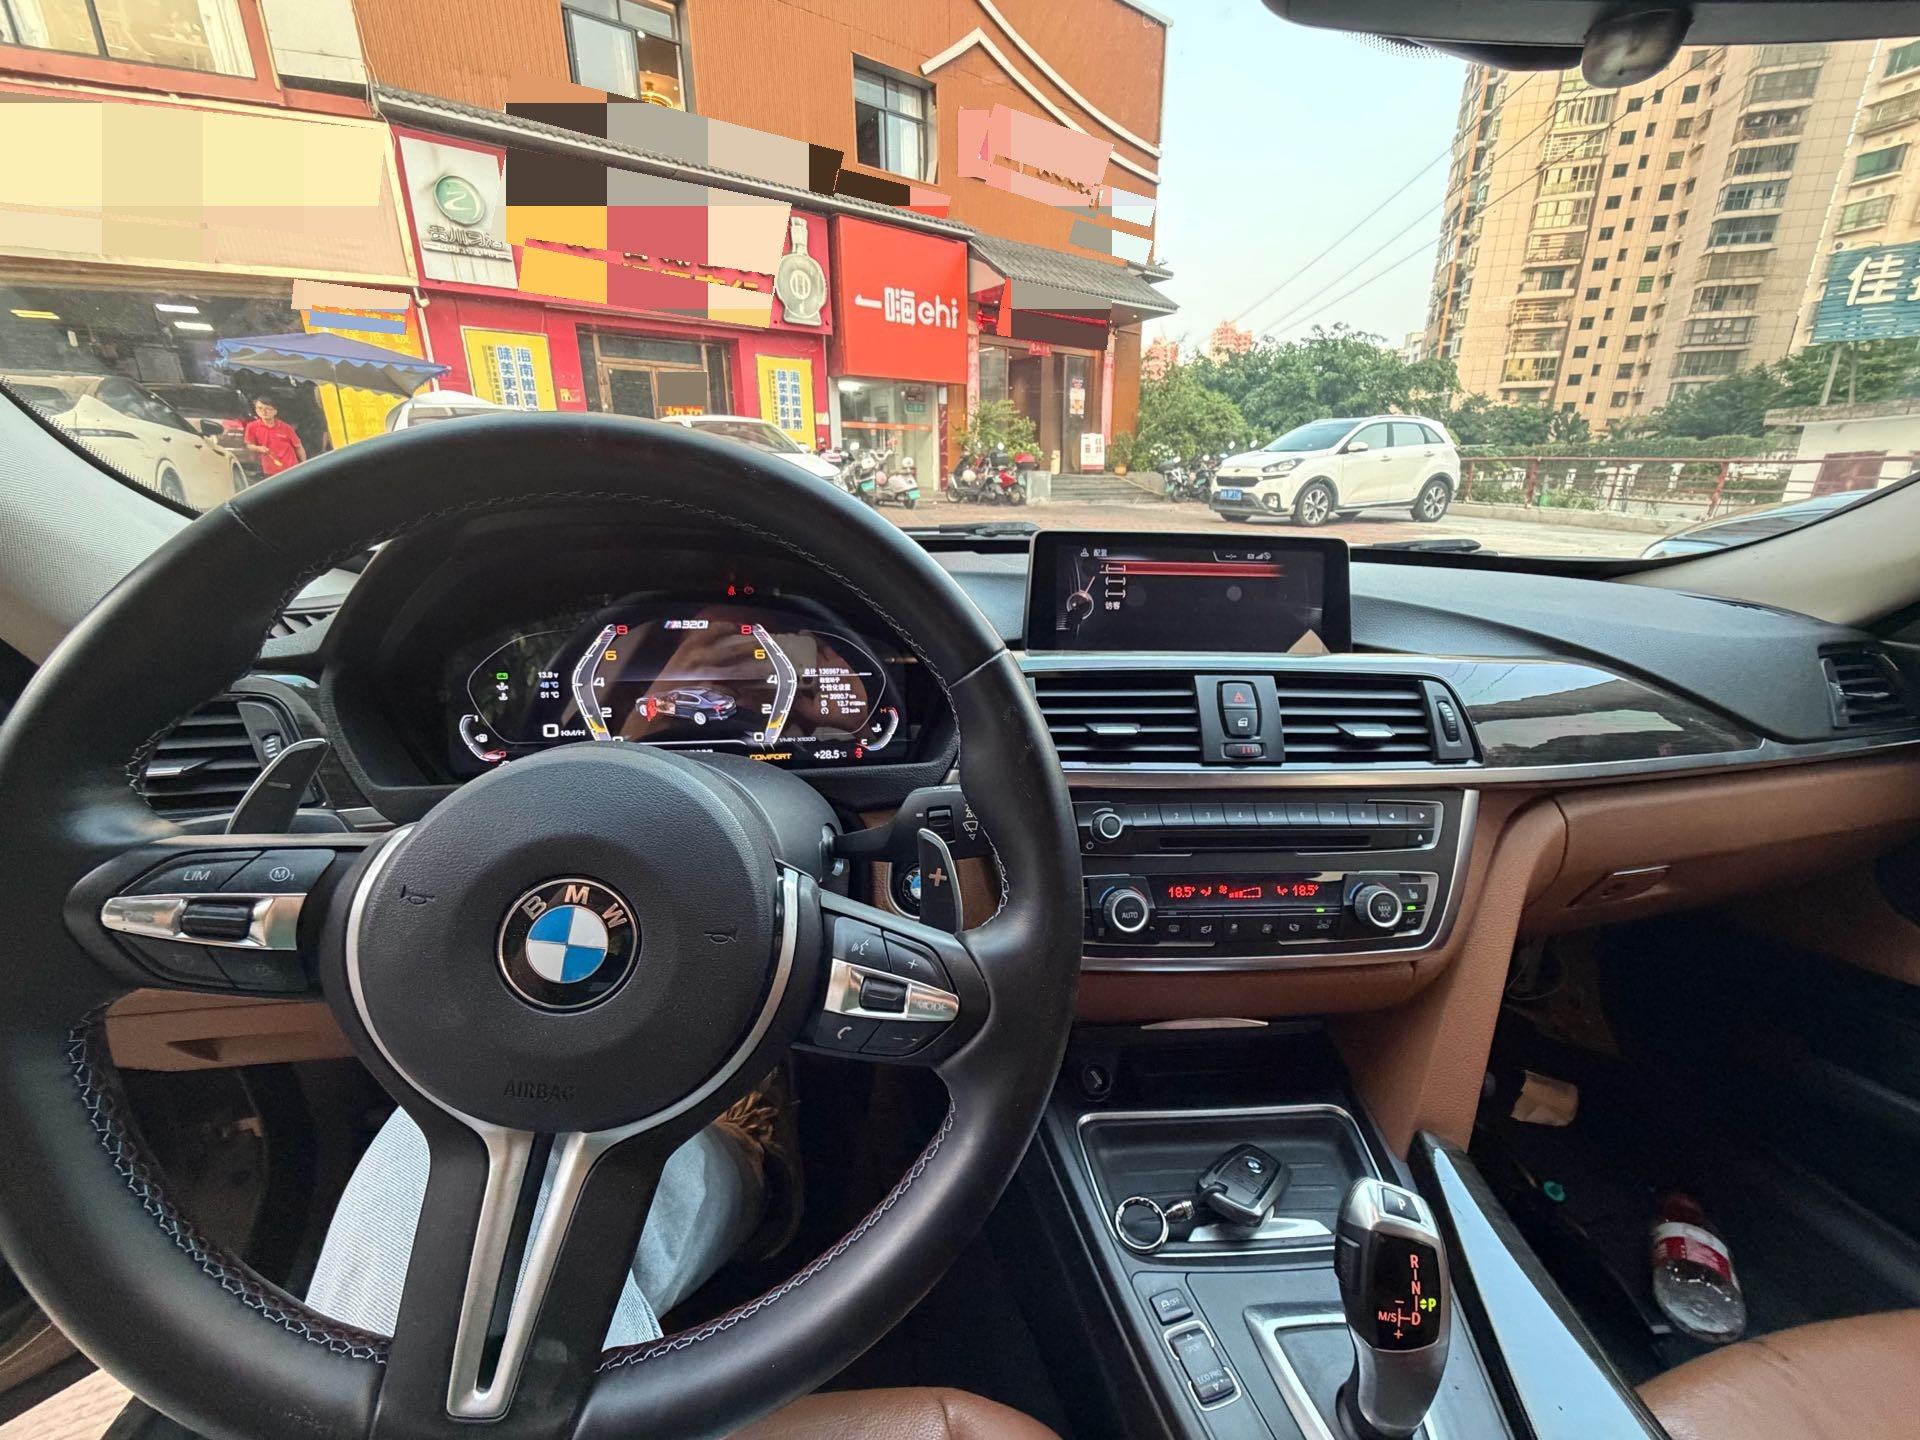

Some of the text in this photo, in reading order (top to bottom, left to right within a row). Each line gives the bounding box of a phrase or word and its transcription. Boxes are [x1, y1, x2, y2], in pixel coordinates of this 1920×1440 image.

[1846, 252, 1920, 307] 佳
[616, 624, 629, 635] 8
[741, 624, 752, 634] 8
[604, 650, 617, 661] 6
[754, 649, 766, 659] 6
[593, 677, 605, 688] 4
[766, 674, 778, 685] 4
[601, 707, 612, 718] 2
[761, 703, 772, 714] 2
[543, 723, 585, 738] 0 KM/H
[753, 732, 765, 742] 0
[749, 752, 793, 761] COMFORT
[813, 750, 840, 759] +28.5
[183, 870, 212, 881] LIM
[521, 884, 628, 929] BMW
[1121, 911, 1139, 919] AUTO
[1406, 917, 1416, 925] A/C
[1398, 1198, 1407, 1211] P
[1410, 1254, 1419, 1269] R
[1411, 1280, 1421, 1295] N
[1427, 1297, 1437, 1312] P
[1377, 1310, 1397, 1323] M/S
[1411, 1311, 1421, 1326] D
